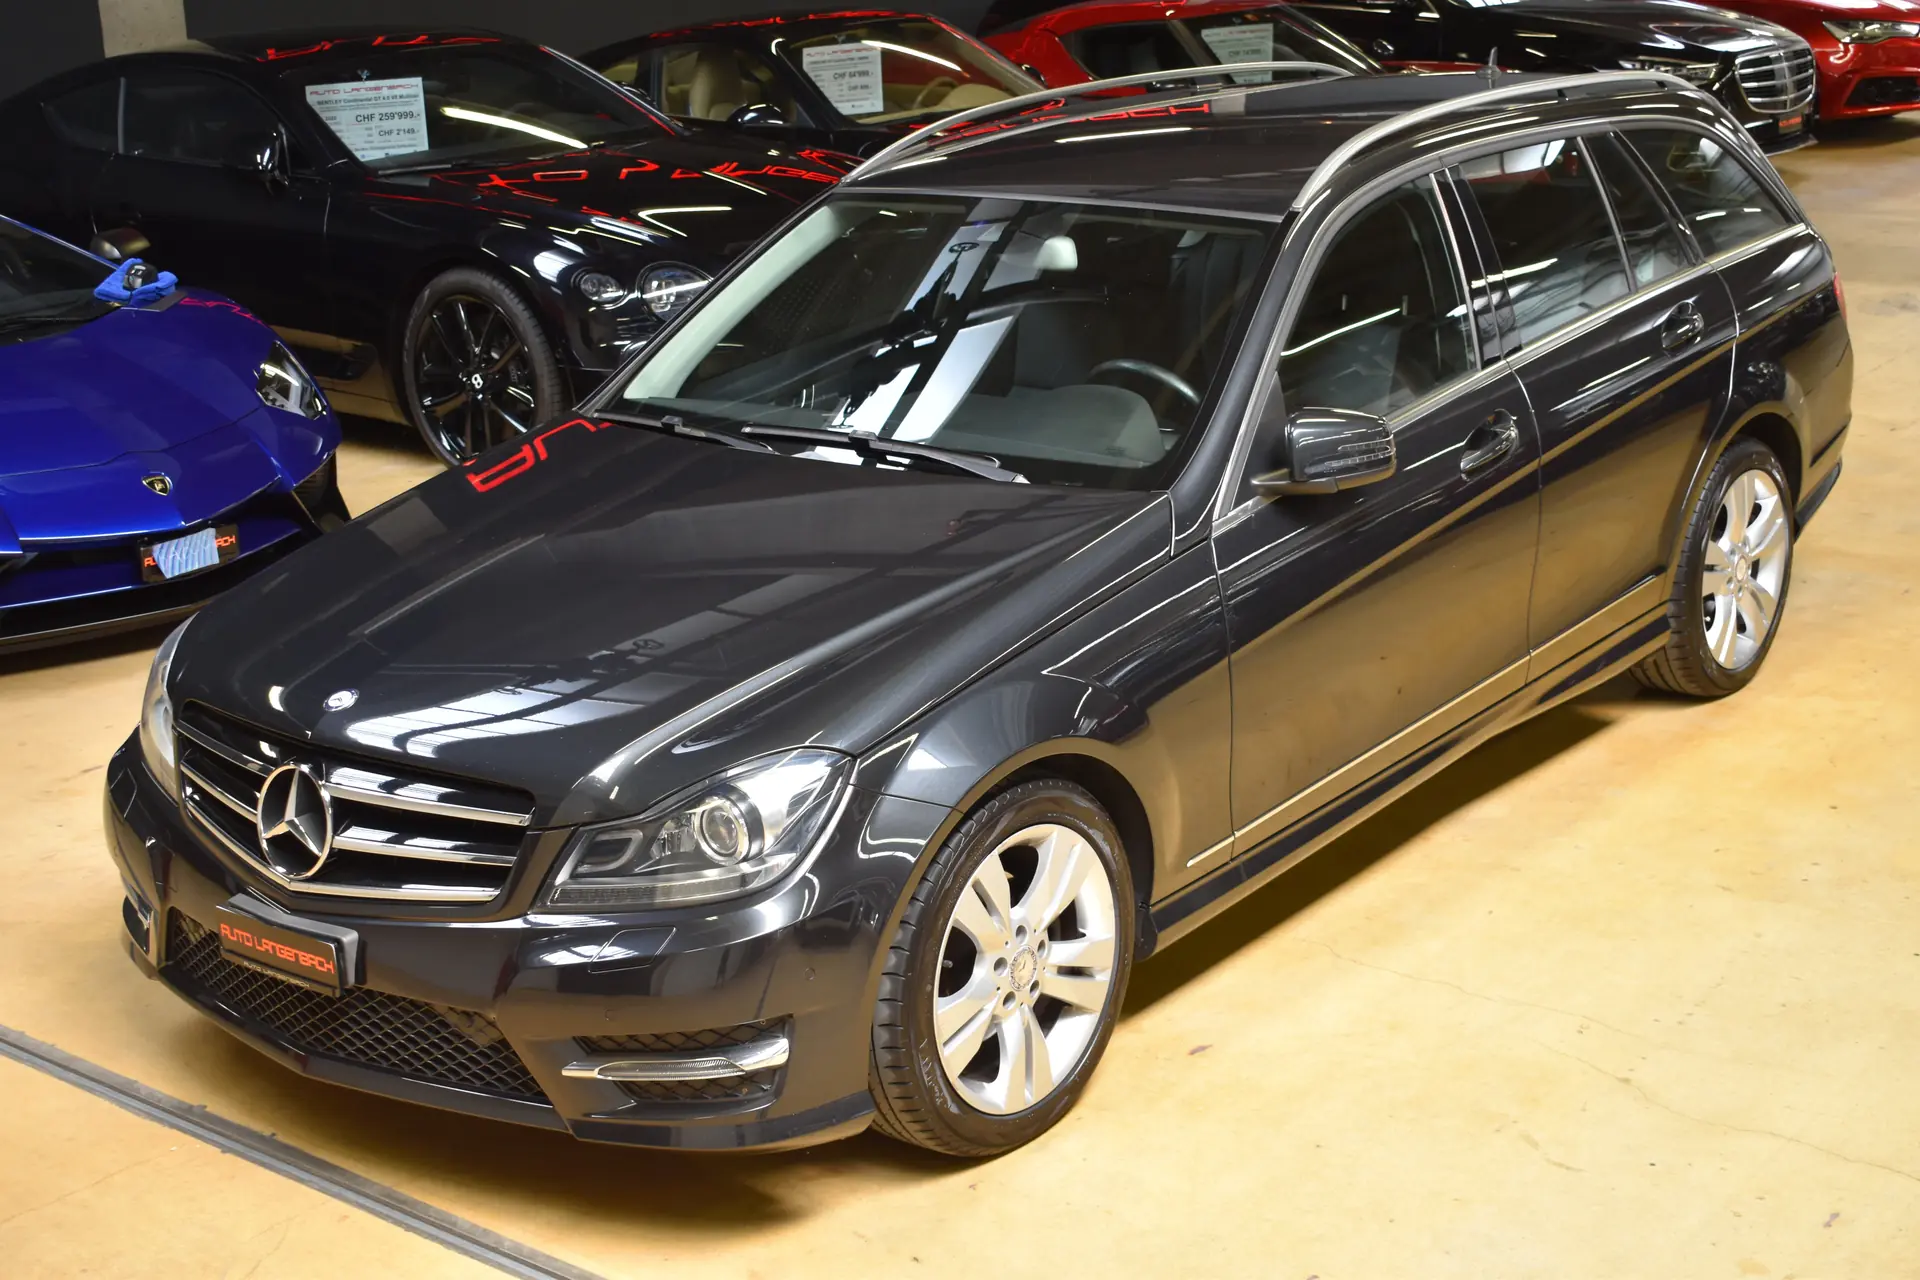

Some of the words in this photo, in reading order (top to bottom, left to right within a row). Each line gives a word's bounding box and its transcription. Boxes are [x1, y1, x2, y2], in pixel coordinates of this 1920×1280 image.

[344, 84, 418, 94] LANGENBACH
[316, 98, 342, 106] BENTLEY
[355, 113, 375, 123] CHF
[378, 111, 421, 121] 259'999.-
[378, 129, 394, 137] CHF
[220, 923, 253, 946] AUTO
[255, 937, 334, 974] LANGENBACH
[244, 961, 261, 972] AUTO
